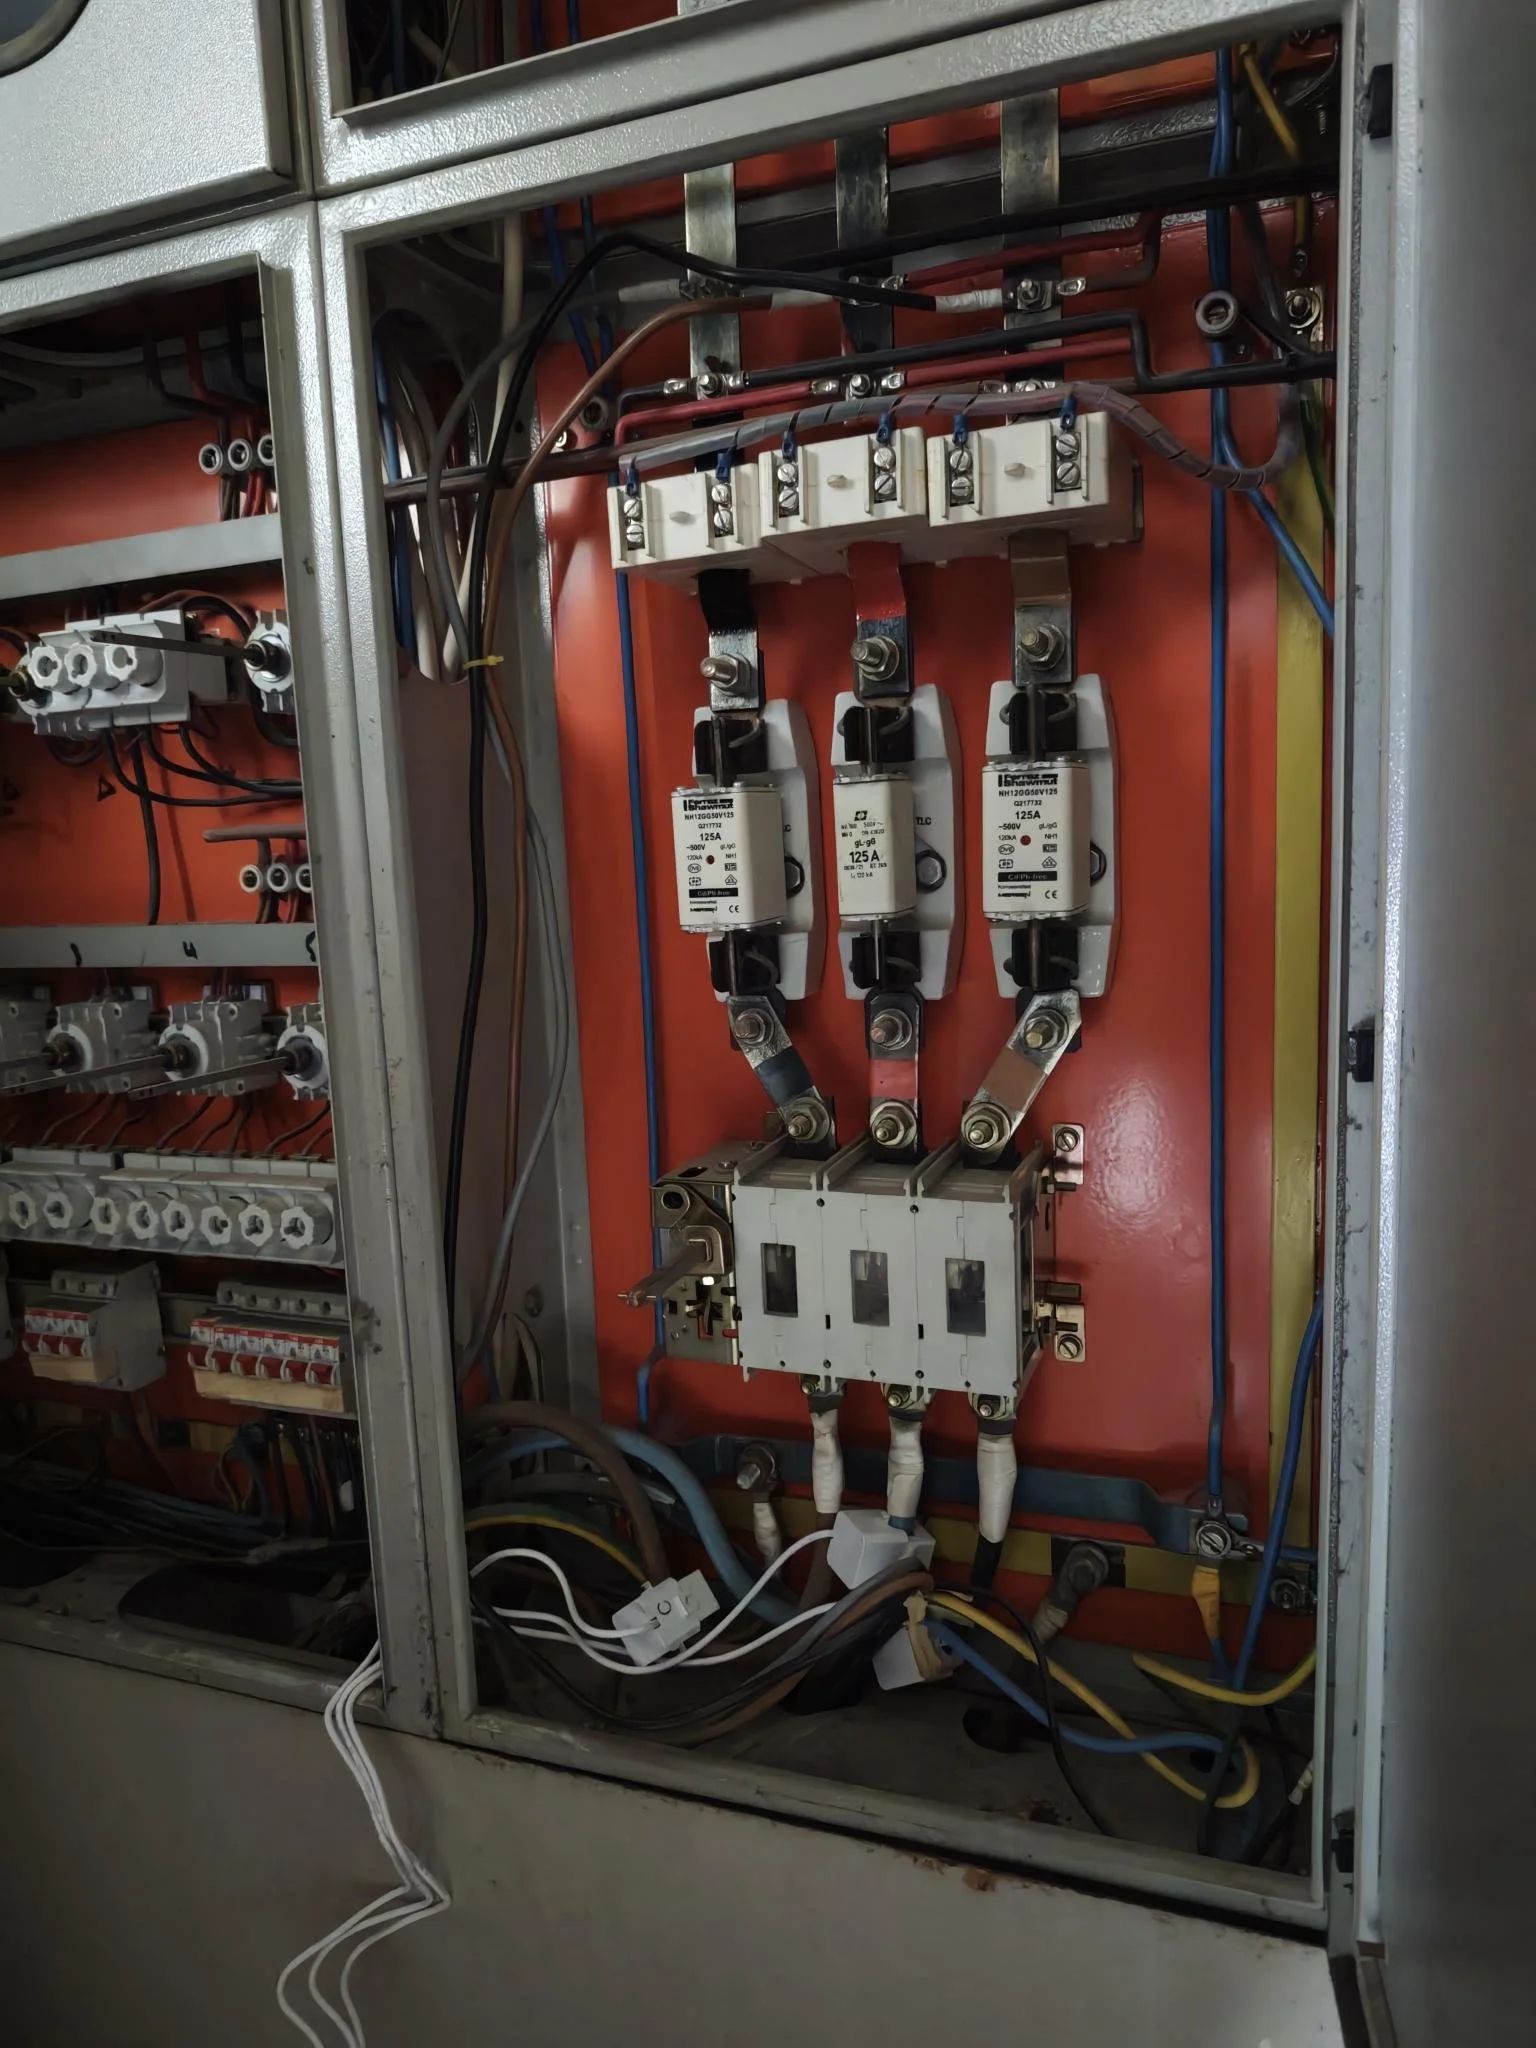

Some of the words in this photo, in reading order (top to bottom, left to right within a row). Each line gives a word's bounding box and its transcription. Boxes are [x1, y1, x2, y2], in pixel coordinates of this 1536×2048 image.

[1015, 810, 1041, 820] 125A
[699, 832, 722, 841] 125A
[849, 850, 869, 863] 125
[871, 849, 880, 862] A
